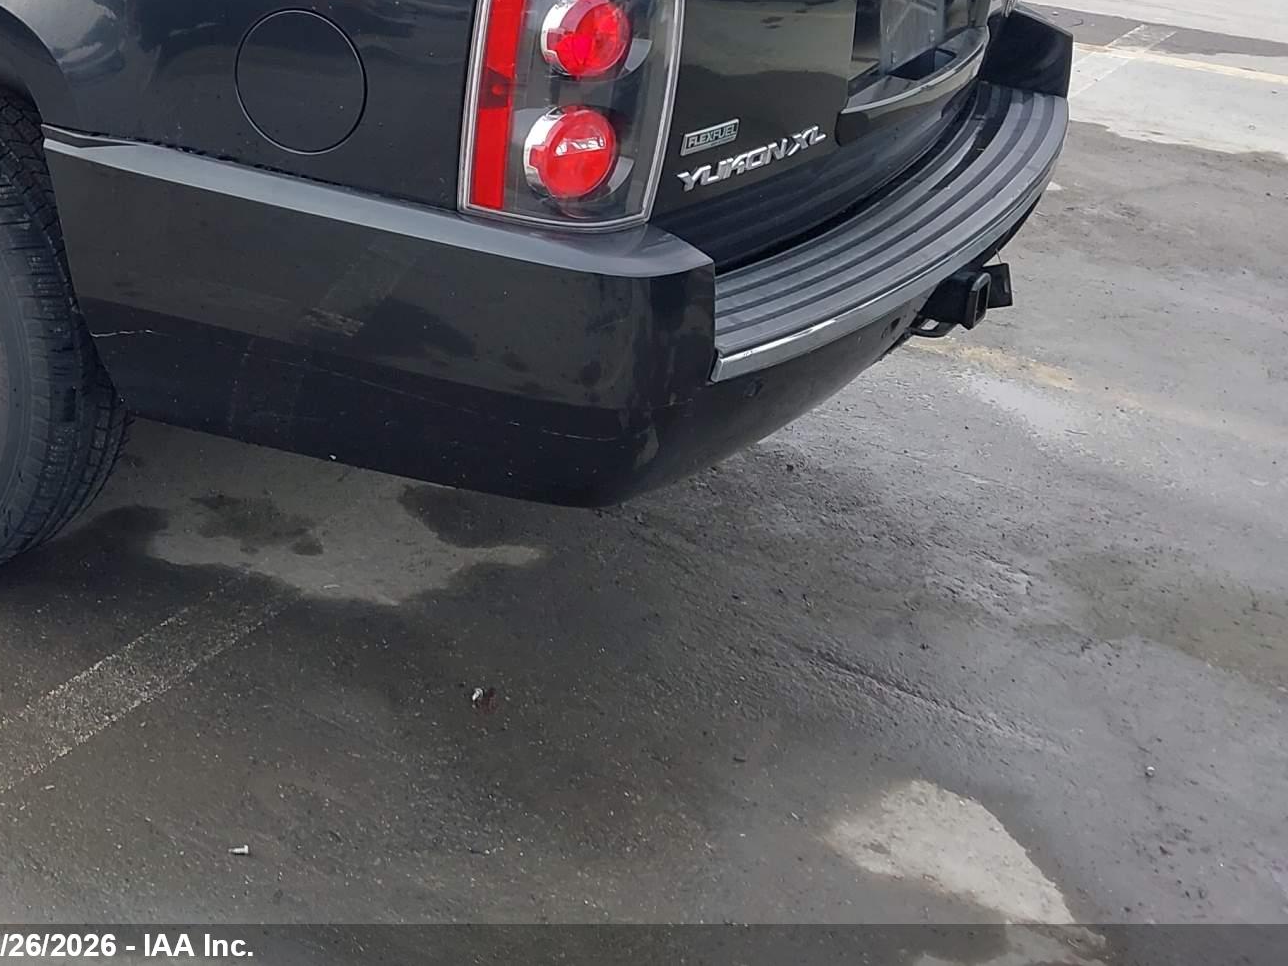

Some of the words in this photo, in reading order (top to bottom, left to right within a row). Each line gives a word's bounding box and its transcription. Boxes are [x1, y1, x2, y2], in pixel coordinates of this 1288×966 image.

[677, 137, 789, 193] YUKON
[786, 125, 827, 158] XL
[687, 124, 738, 149] FLEXFUEL
